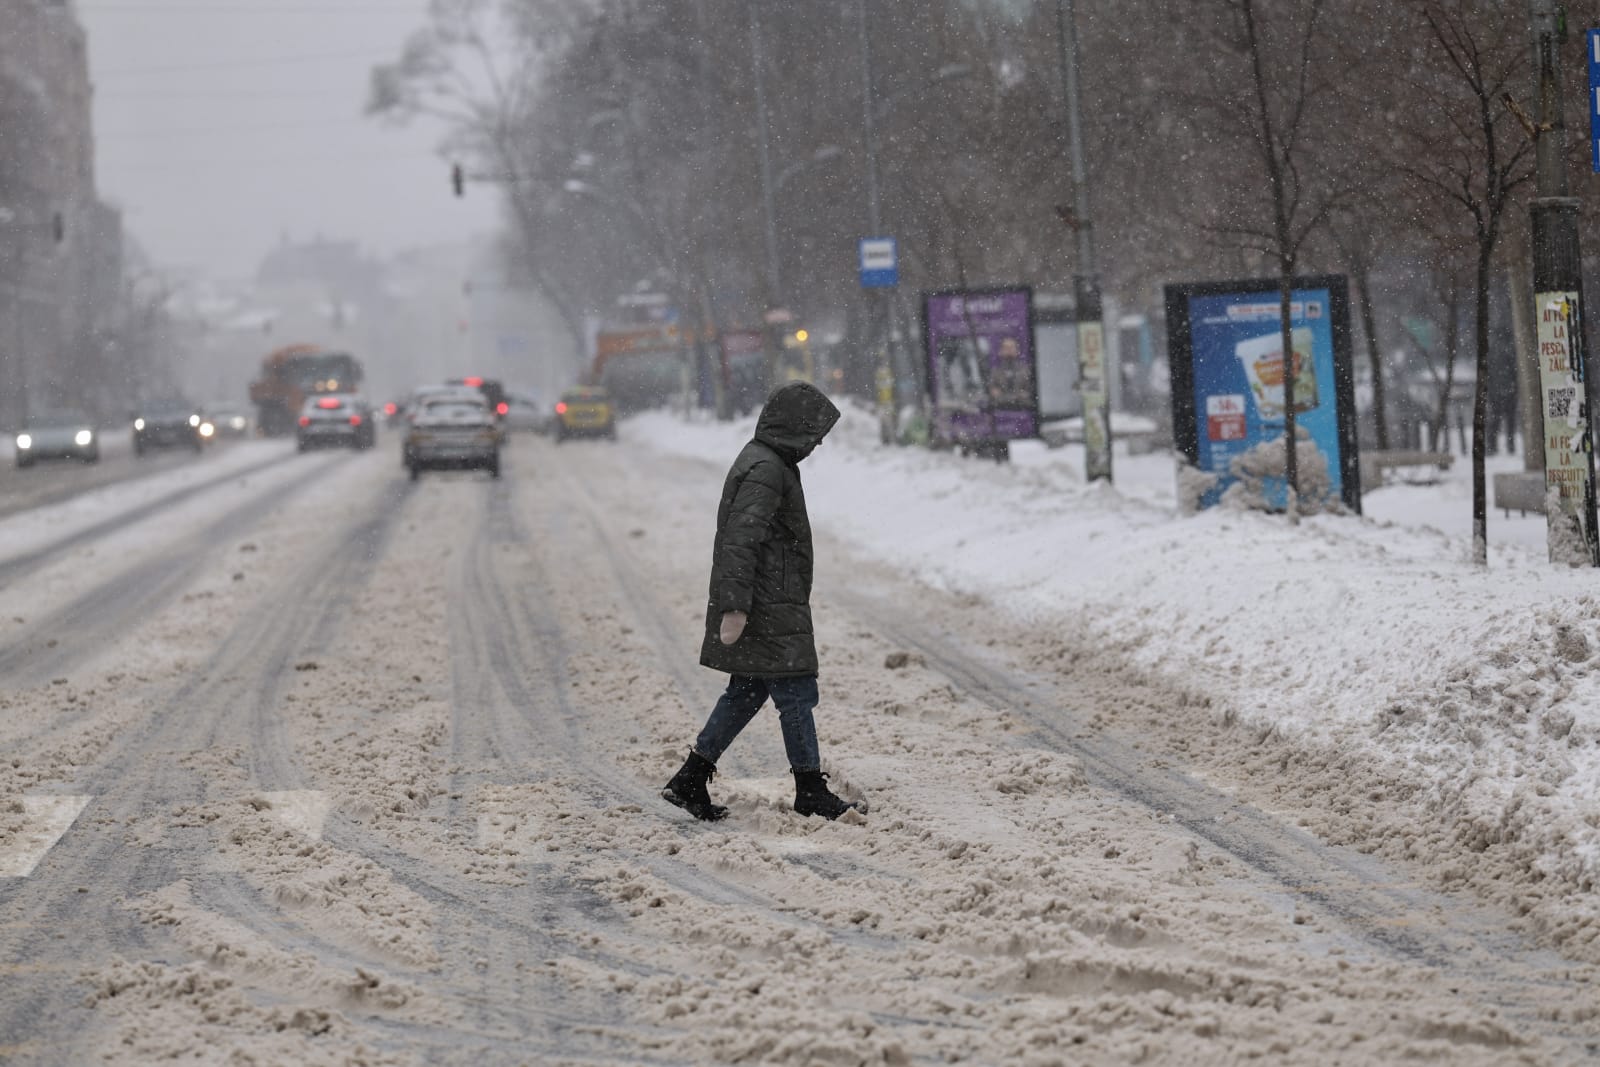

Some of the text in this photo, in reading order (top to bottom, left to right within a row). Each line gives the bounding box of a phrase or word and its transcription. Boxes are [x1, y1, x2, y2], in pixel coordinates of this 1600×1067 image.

[1554, 325, 1565, 339] LA
[1550, 435, 1557, 449] AI
[1560, 452, 1571, 465] LA
